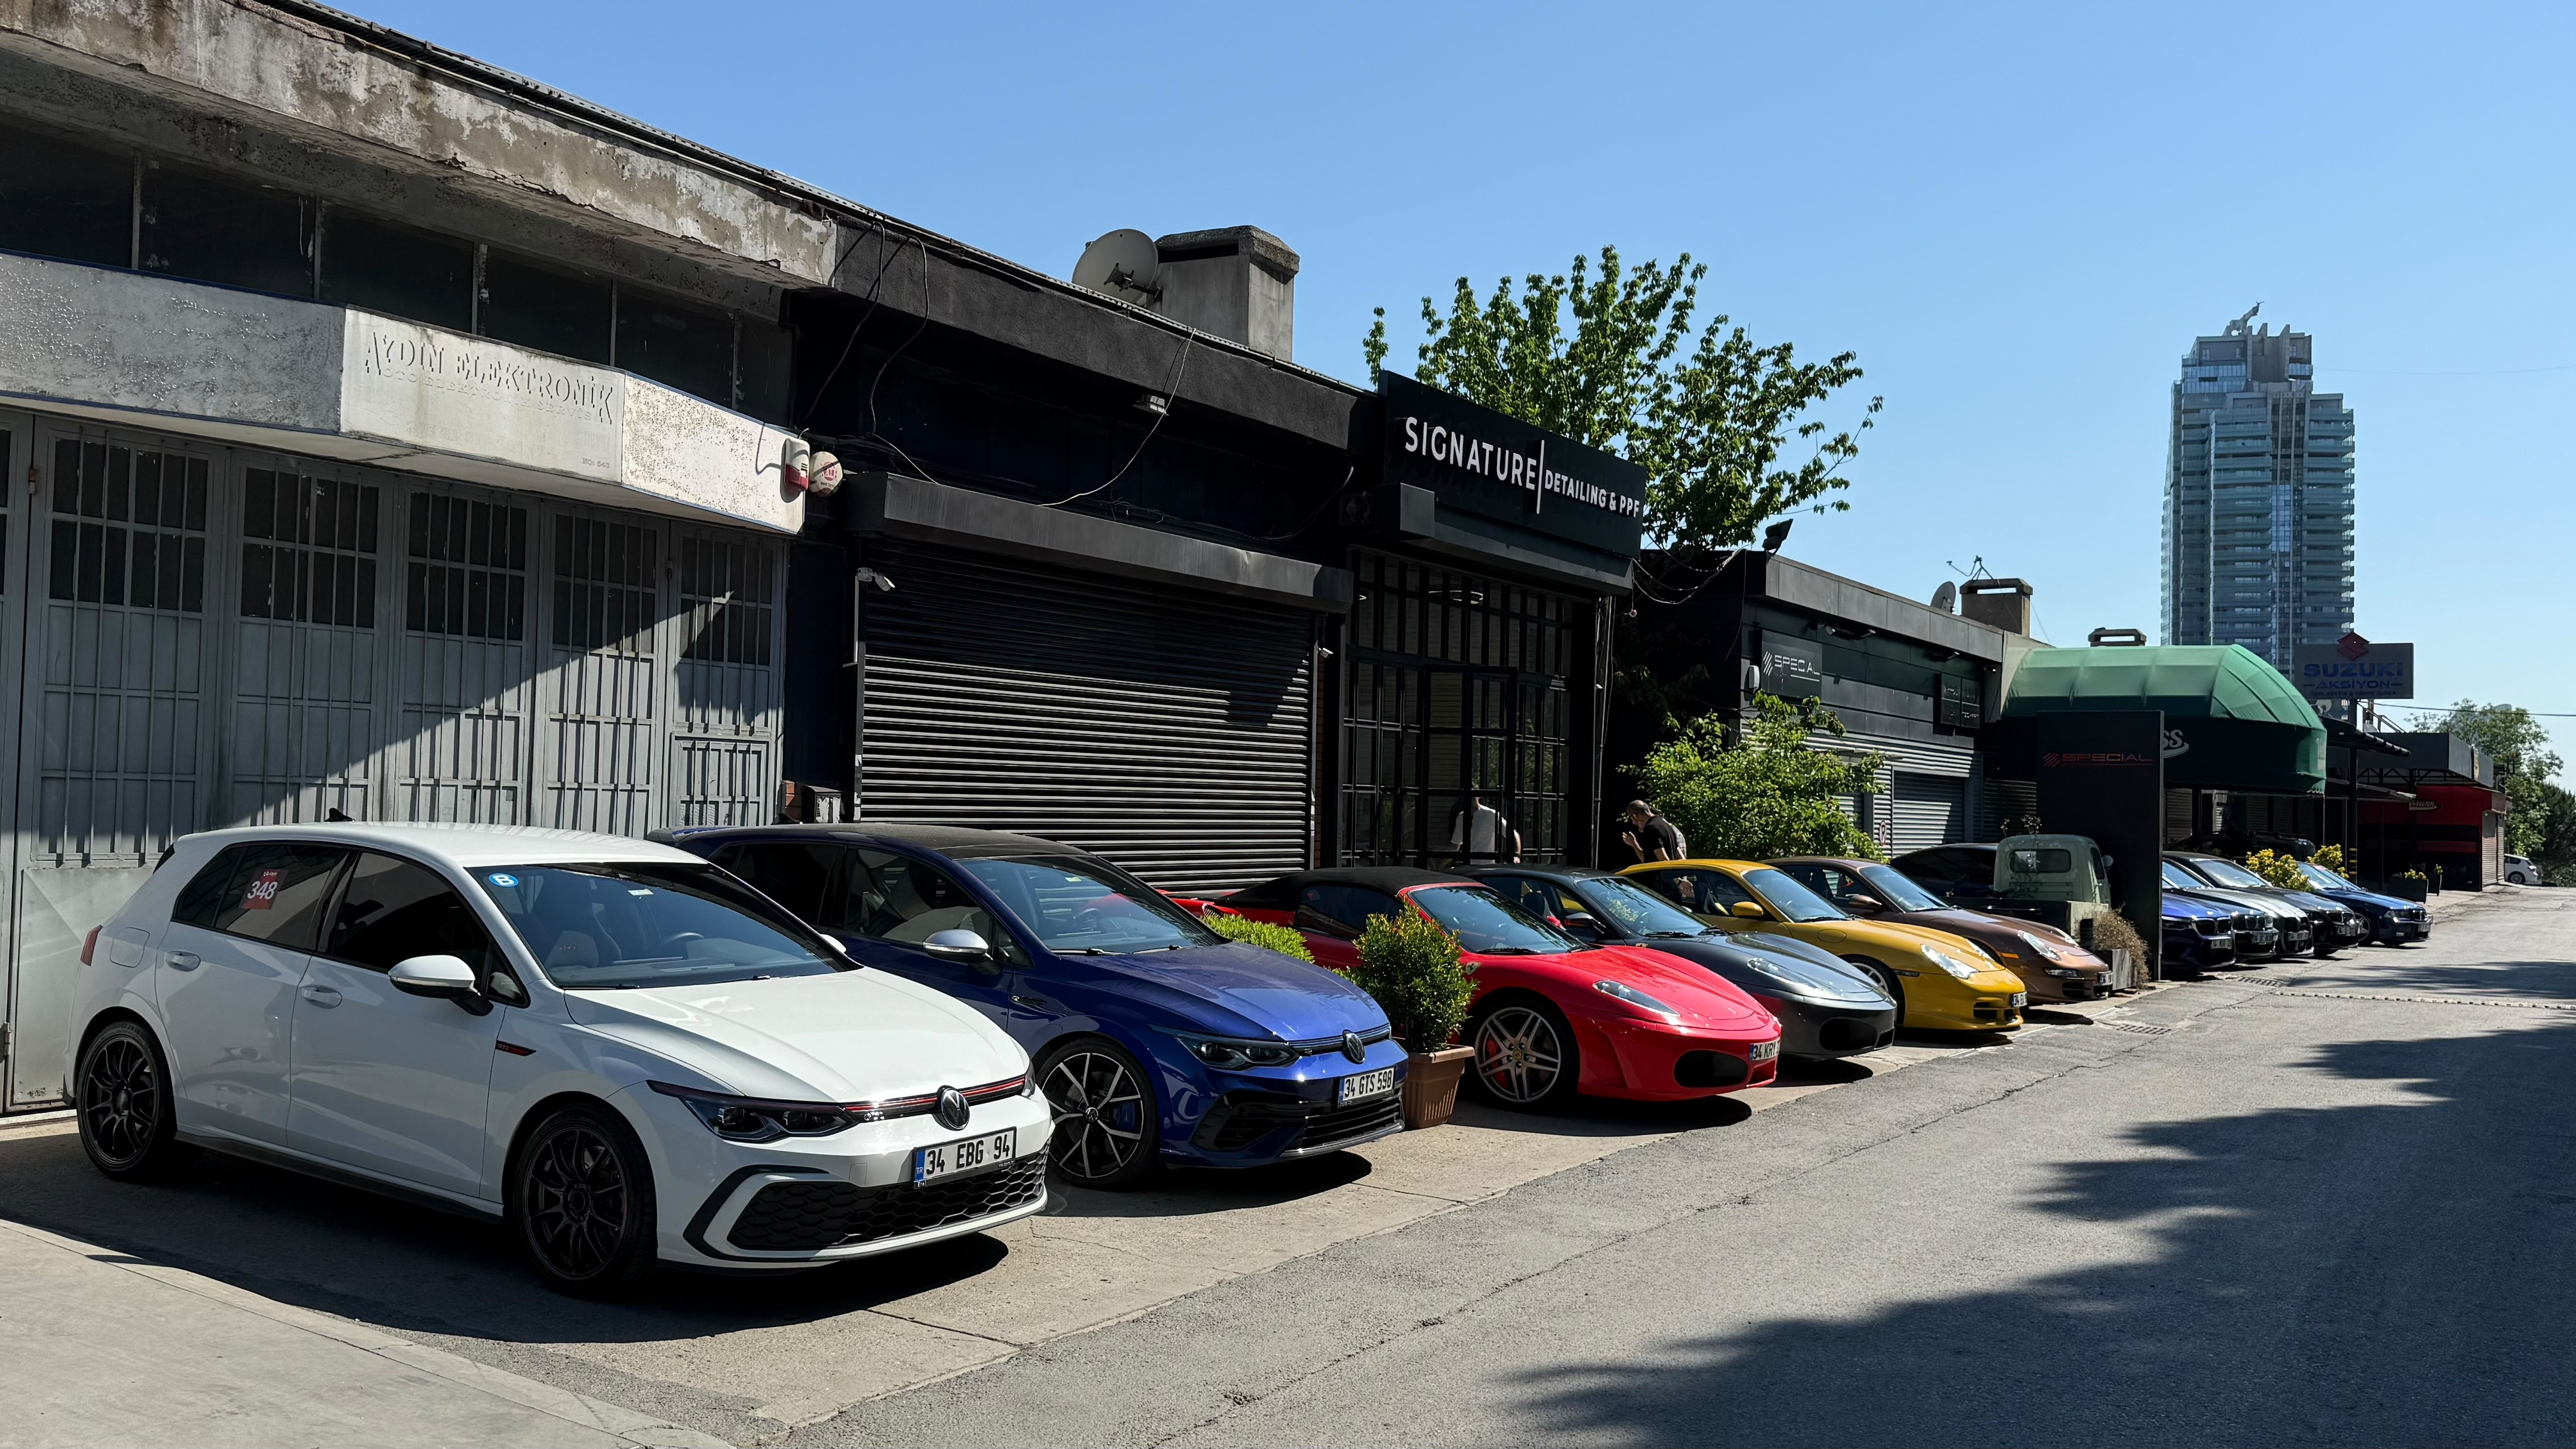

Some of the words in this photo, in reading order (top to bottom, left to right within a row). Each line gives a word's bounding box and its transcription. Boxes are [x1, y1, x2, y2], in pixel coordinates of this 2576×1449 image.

[365, 331, 445, 376] AYDIN
[1405, 416, 1538, 491] SIGNATURE
[1544, 469, 1607, 509] DETAILING
[1609, 491, 1617, 511] &
[1619, 495, 1640, 518] PPF
[1774, 654, 1821, 676] SPECIAL
[2303, 662, 2403, 677] SUZUKI
[2315, 678, 2390, 689] AKSİYON
[2062, 753, 2154, 762] SPECIAL
[247, 880, 278, 900] 348
[1752, 1044, 1762, 1060] 34
[1344, 1078, 1355, 1097] 34
[1359, 1074, 1376, 1095] GTS
[1377, 1070, 1392, 1091] 598
[926, 1148, 945, 1175] 34
[956, 1140, 984, 1169] EBG
[993, 1134, 1010, 1160] 94
